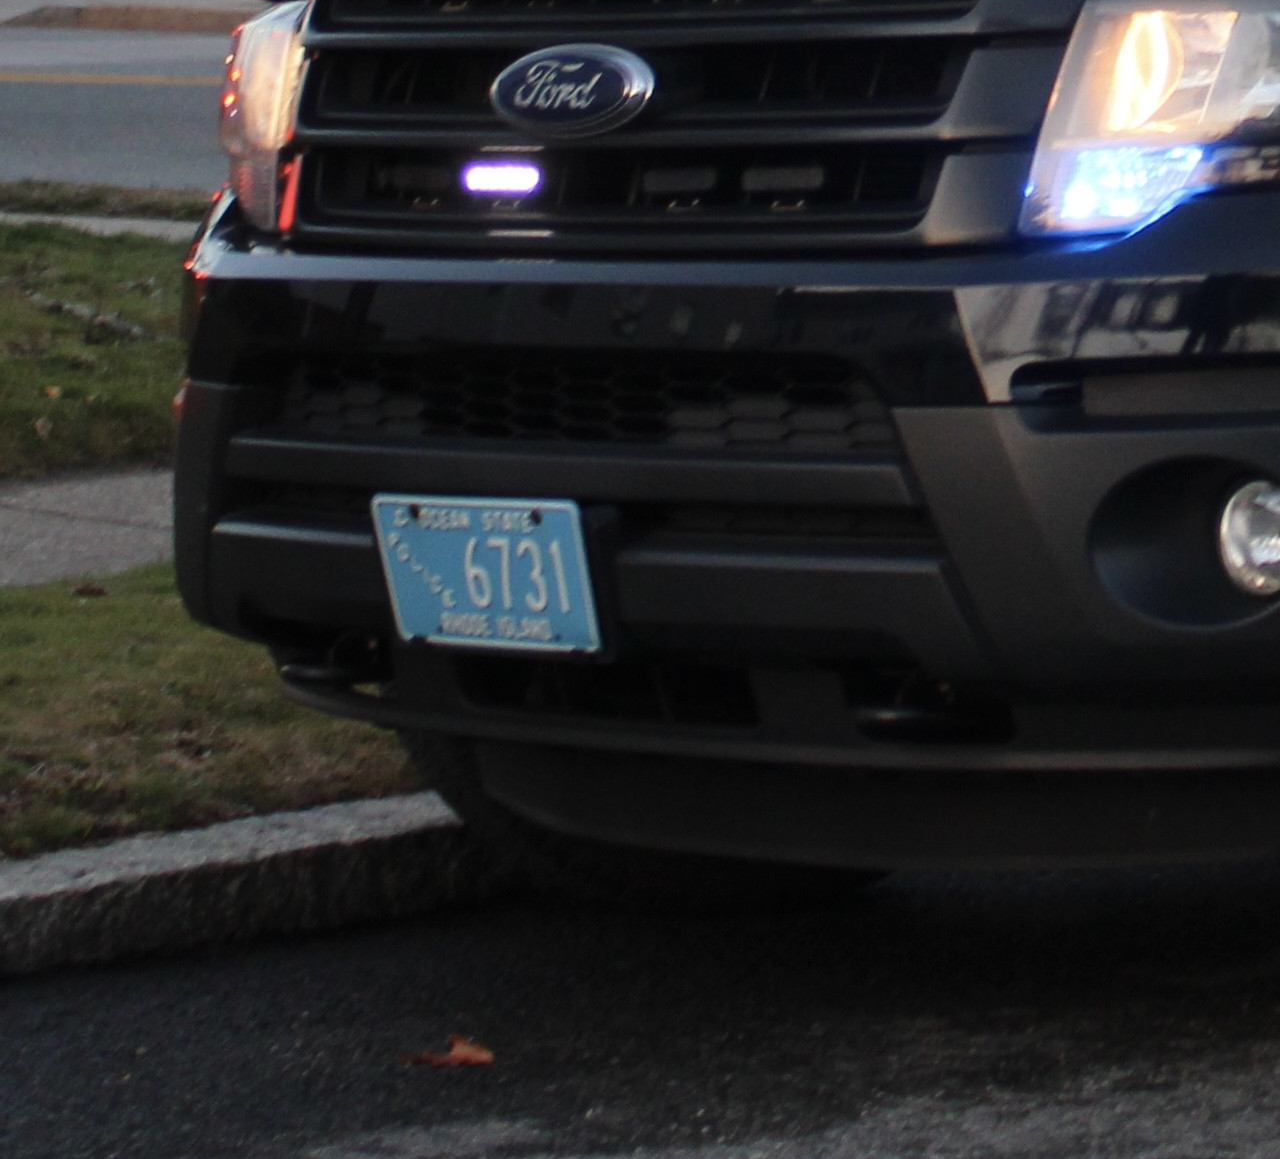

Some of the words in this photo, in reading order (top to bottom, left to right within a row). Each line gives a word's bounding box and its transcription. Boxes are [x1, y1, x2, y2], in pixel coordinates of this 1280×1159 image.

[513, 60, 602, 110] Ford
[482, 511, 536, 534] STATE
[463, 537, 571, 614] 6731
